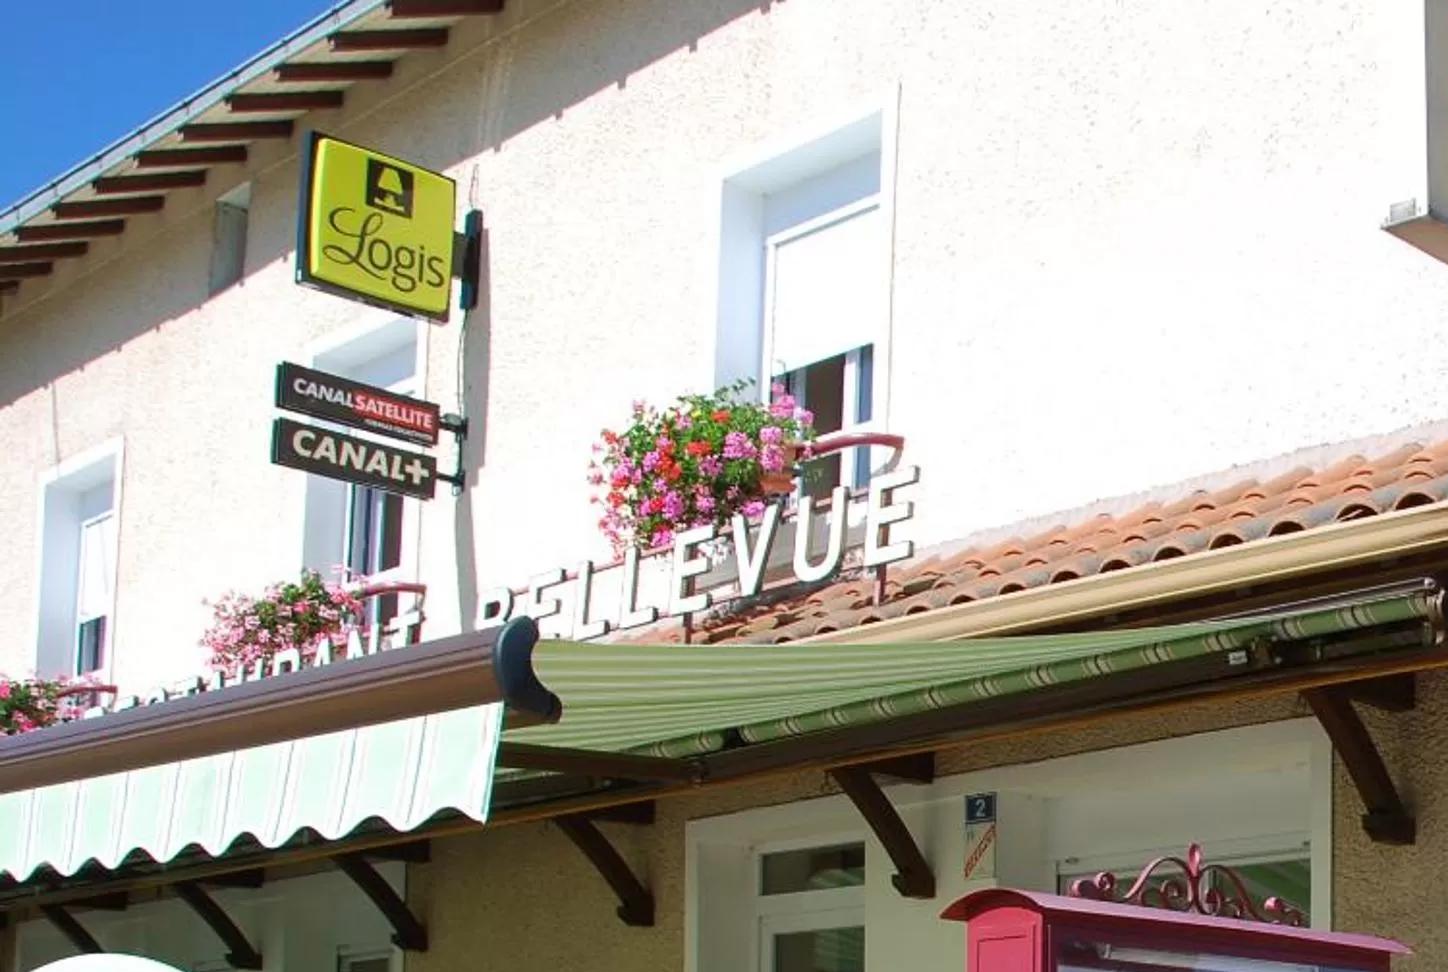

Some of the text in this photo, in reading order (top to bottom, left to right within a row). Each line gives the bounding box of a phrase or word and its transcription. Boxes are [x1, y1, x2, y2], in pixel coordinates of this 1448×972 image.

[322, 206, 446, 293] Logis
[293, 430, 430, 485] CANAL+
[975, 798, 986, 817] 2
